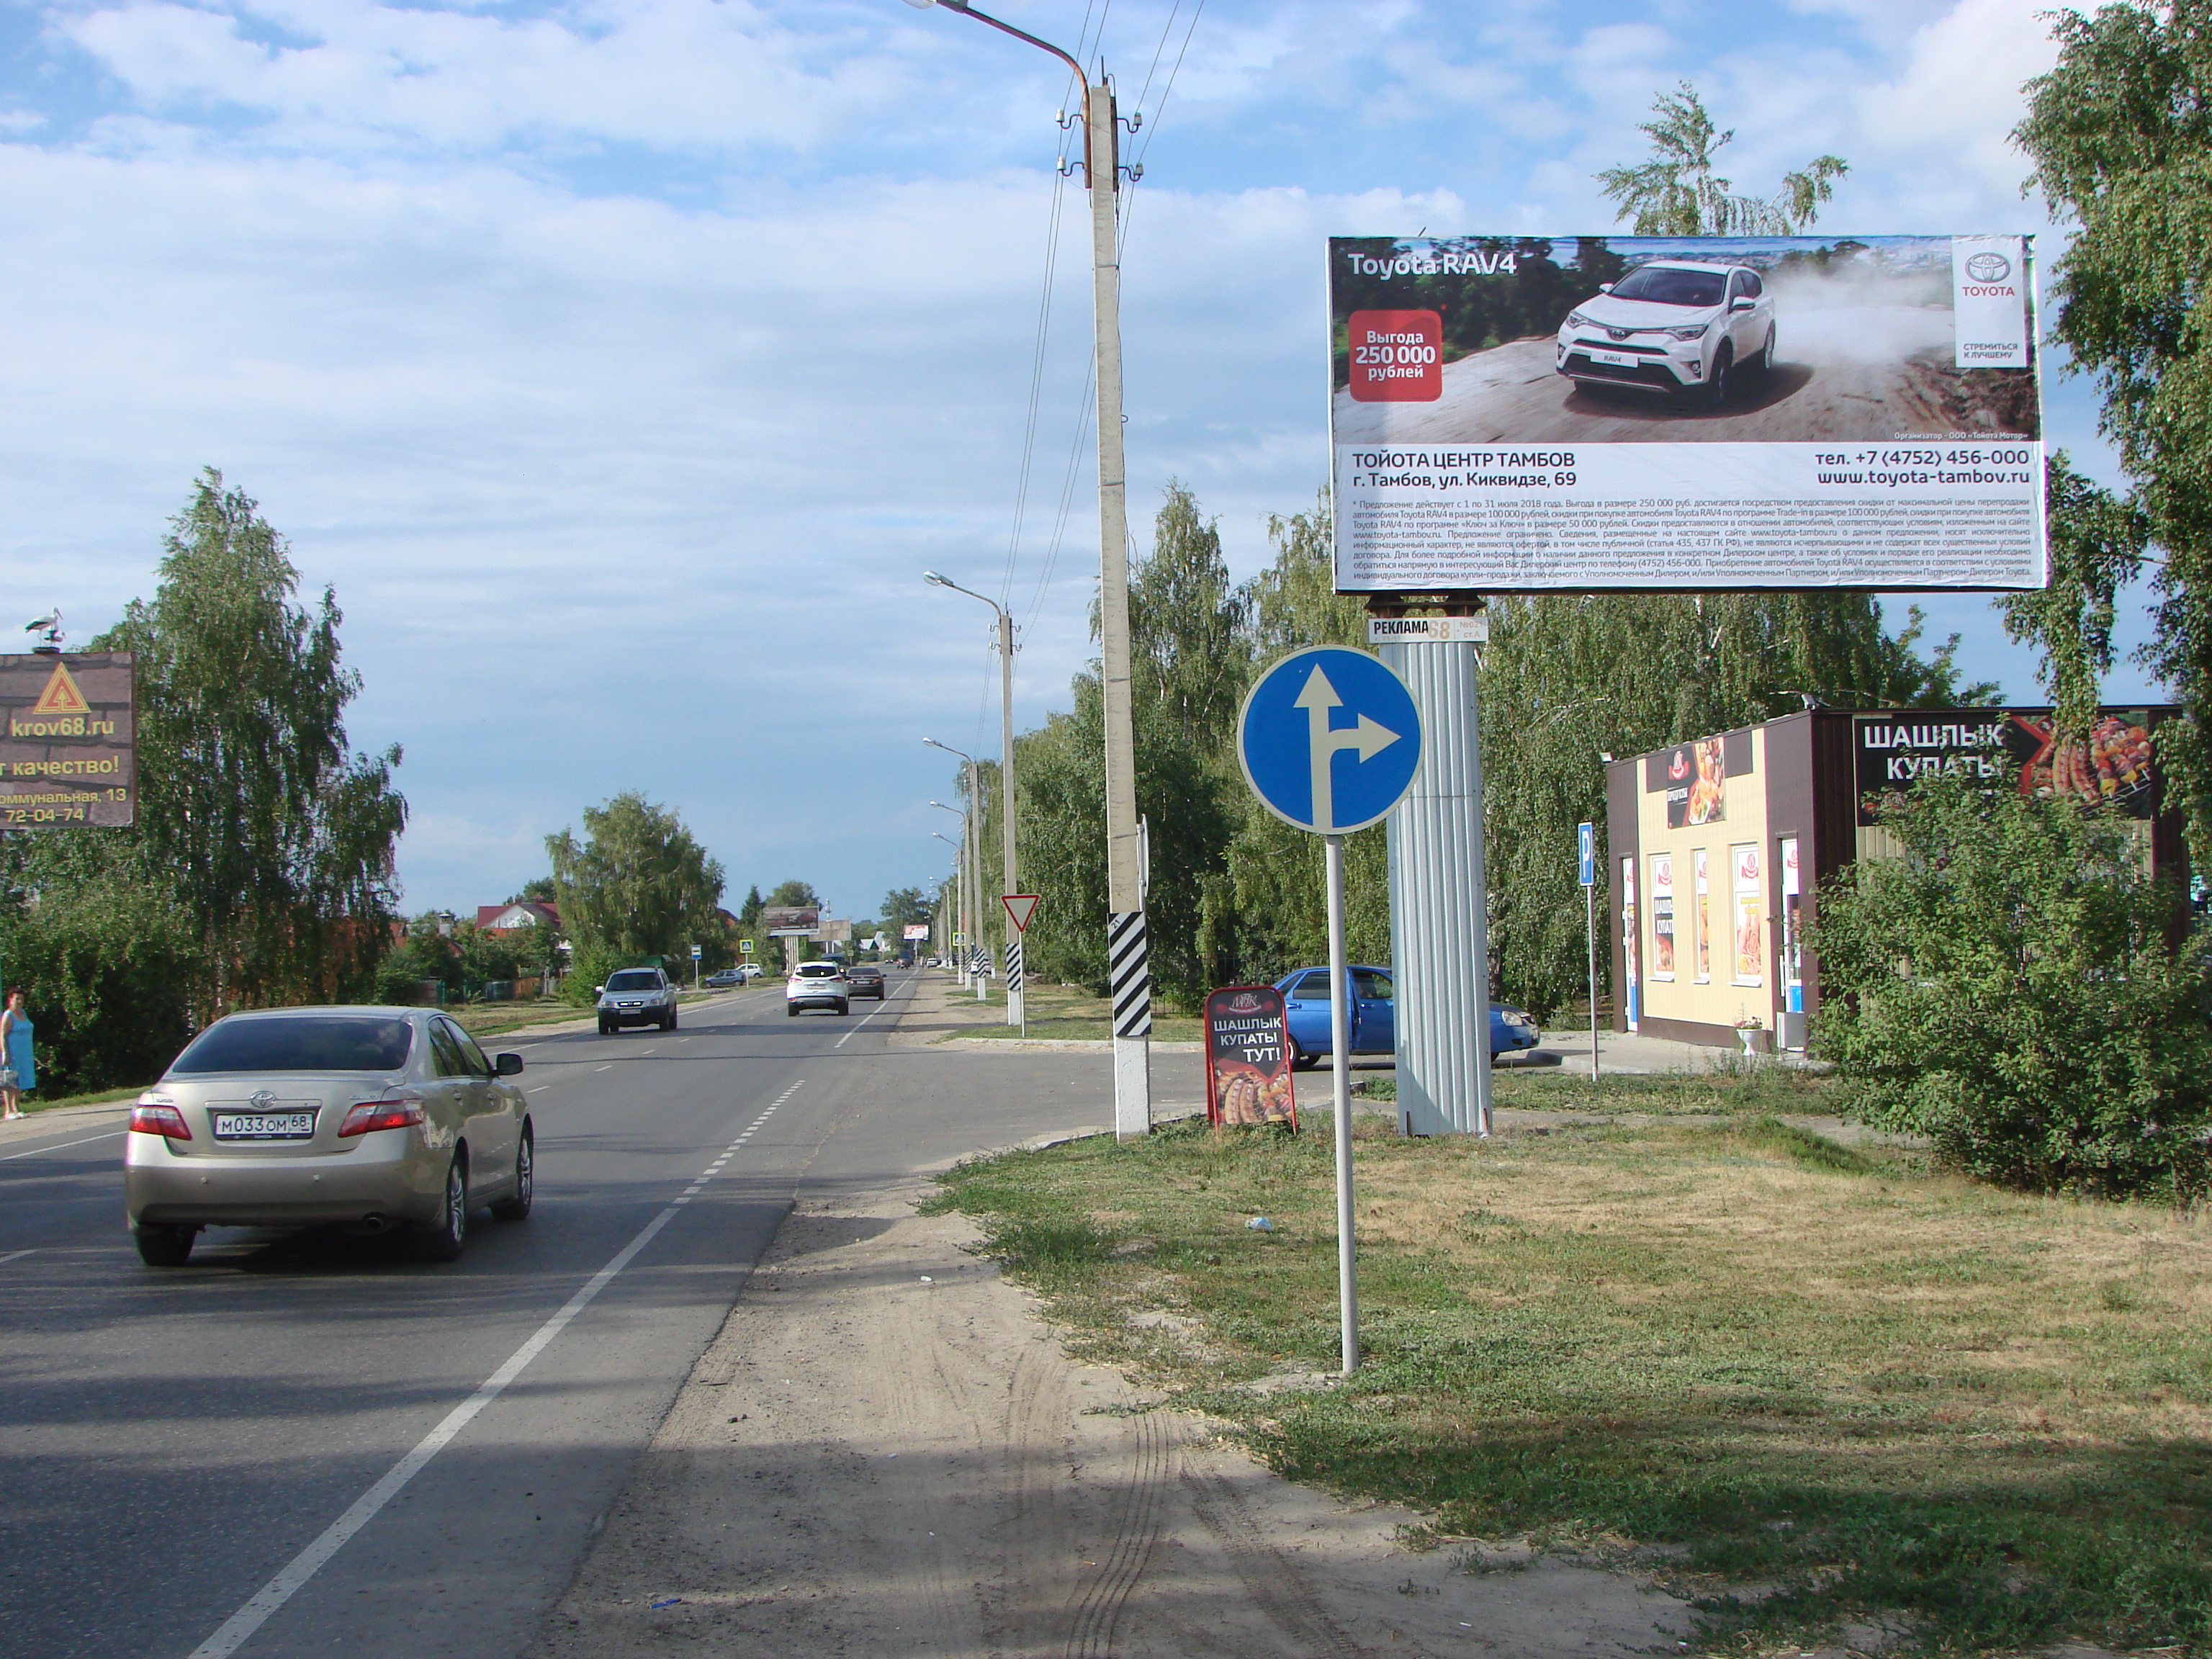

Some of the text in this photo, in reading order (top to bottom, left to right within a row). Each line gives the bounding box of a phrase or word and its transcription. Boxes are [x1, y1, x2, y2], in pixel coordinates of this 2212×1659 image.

[1348, 253, 1517, 281] Toyota RAV4
[1962, 287, 2015, 296] TOYOTA
[1367, 331, 1424, 346] Выгода
[1355, 346, 1436, 365] 250 000
[1367, 364, 1424, 382] рублей
[1352, 450, 1575, 469] ТОЙОТА ЦЕНТР ТАМБОВ
[1815, 450, 2029, 467] тел. +7 (4752) 456-000
[1353, 472, 1576, 490] г. Тамбов, ул. Киквидзе, 69
[1817, 469, 2030, 487] www.toyota-tambov.ru
[11, 717, 114, 737] krov68.ru
[1864, 724, 2005, 748] ШАШЛЫК
[12, 755, 120, 775] качество!
[106, 788, 127, 801] 13
[4, 808, 85, 823] 72-04-74
[1213, 1017, 1282, 1032] ШАШЛЫК
[1220, 1032, 1278, 1046] КУПАТЫ
[1243, 1047, 1281, 1063] ТУТ!
[291, 1115, 307, 1127] 68
